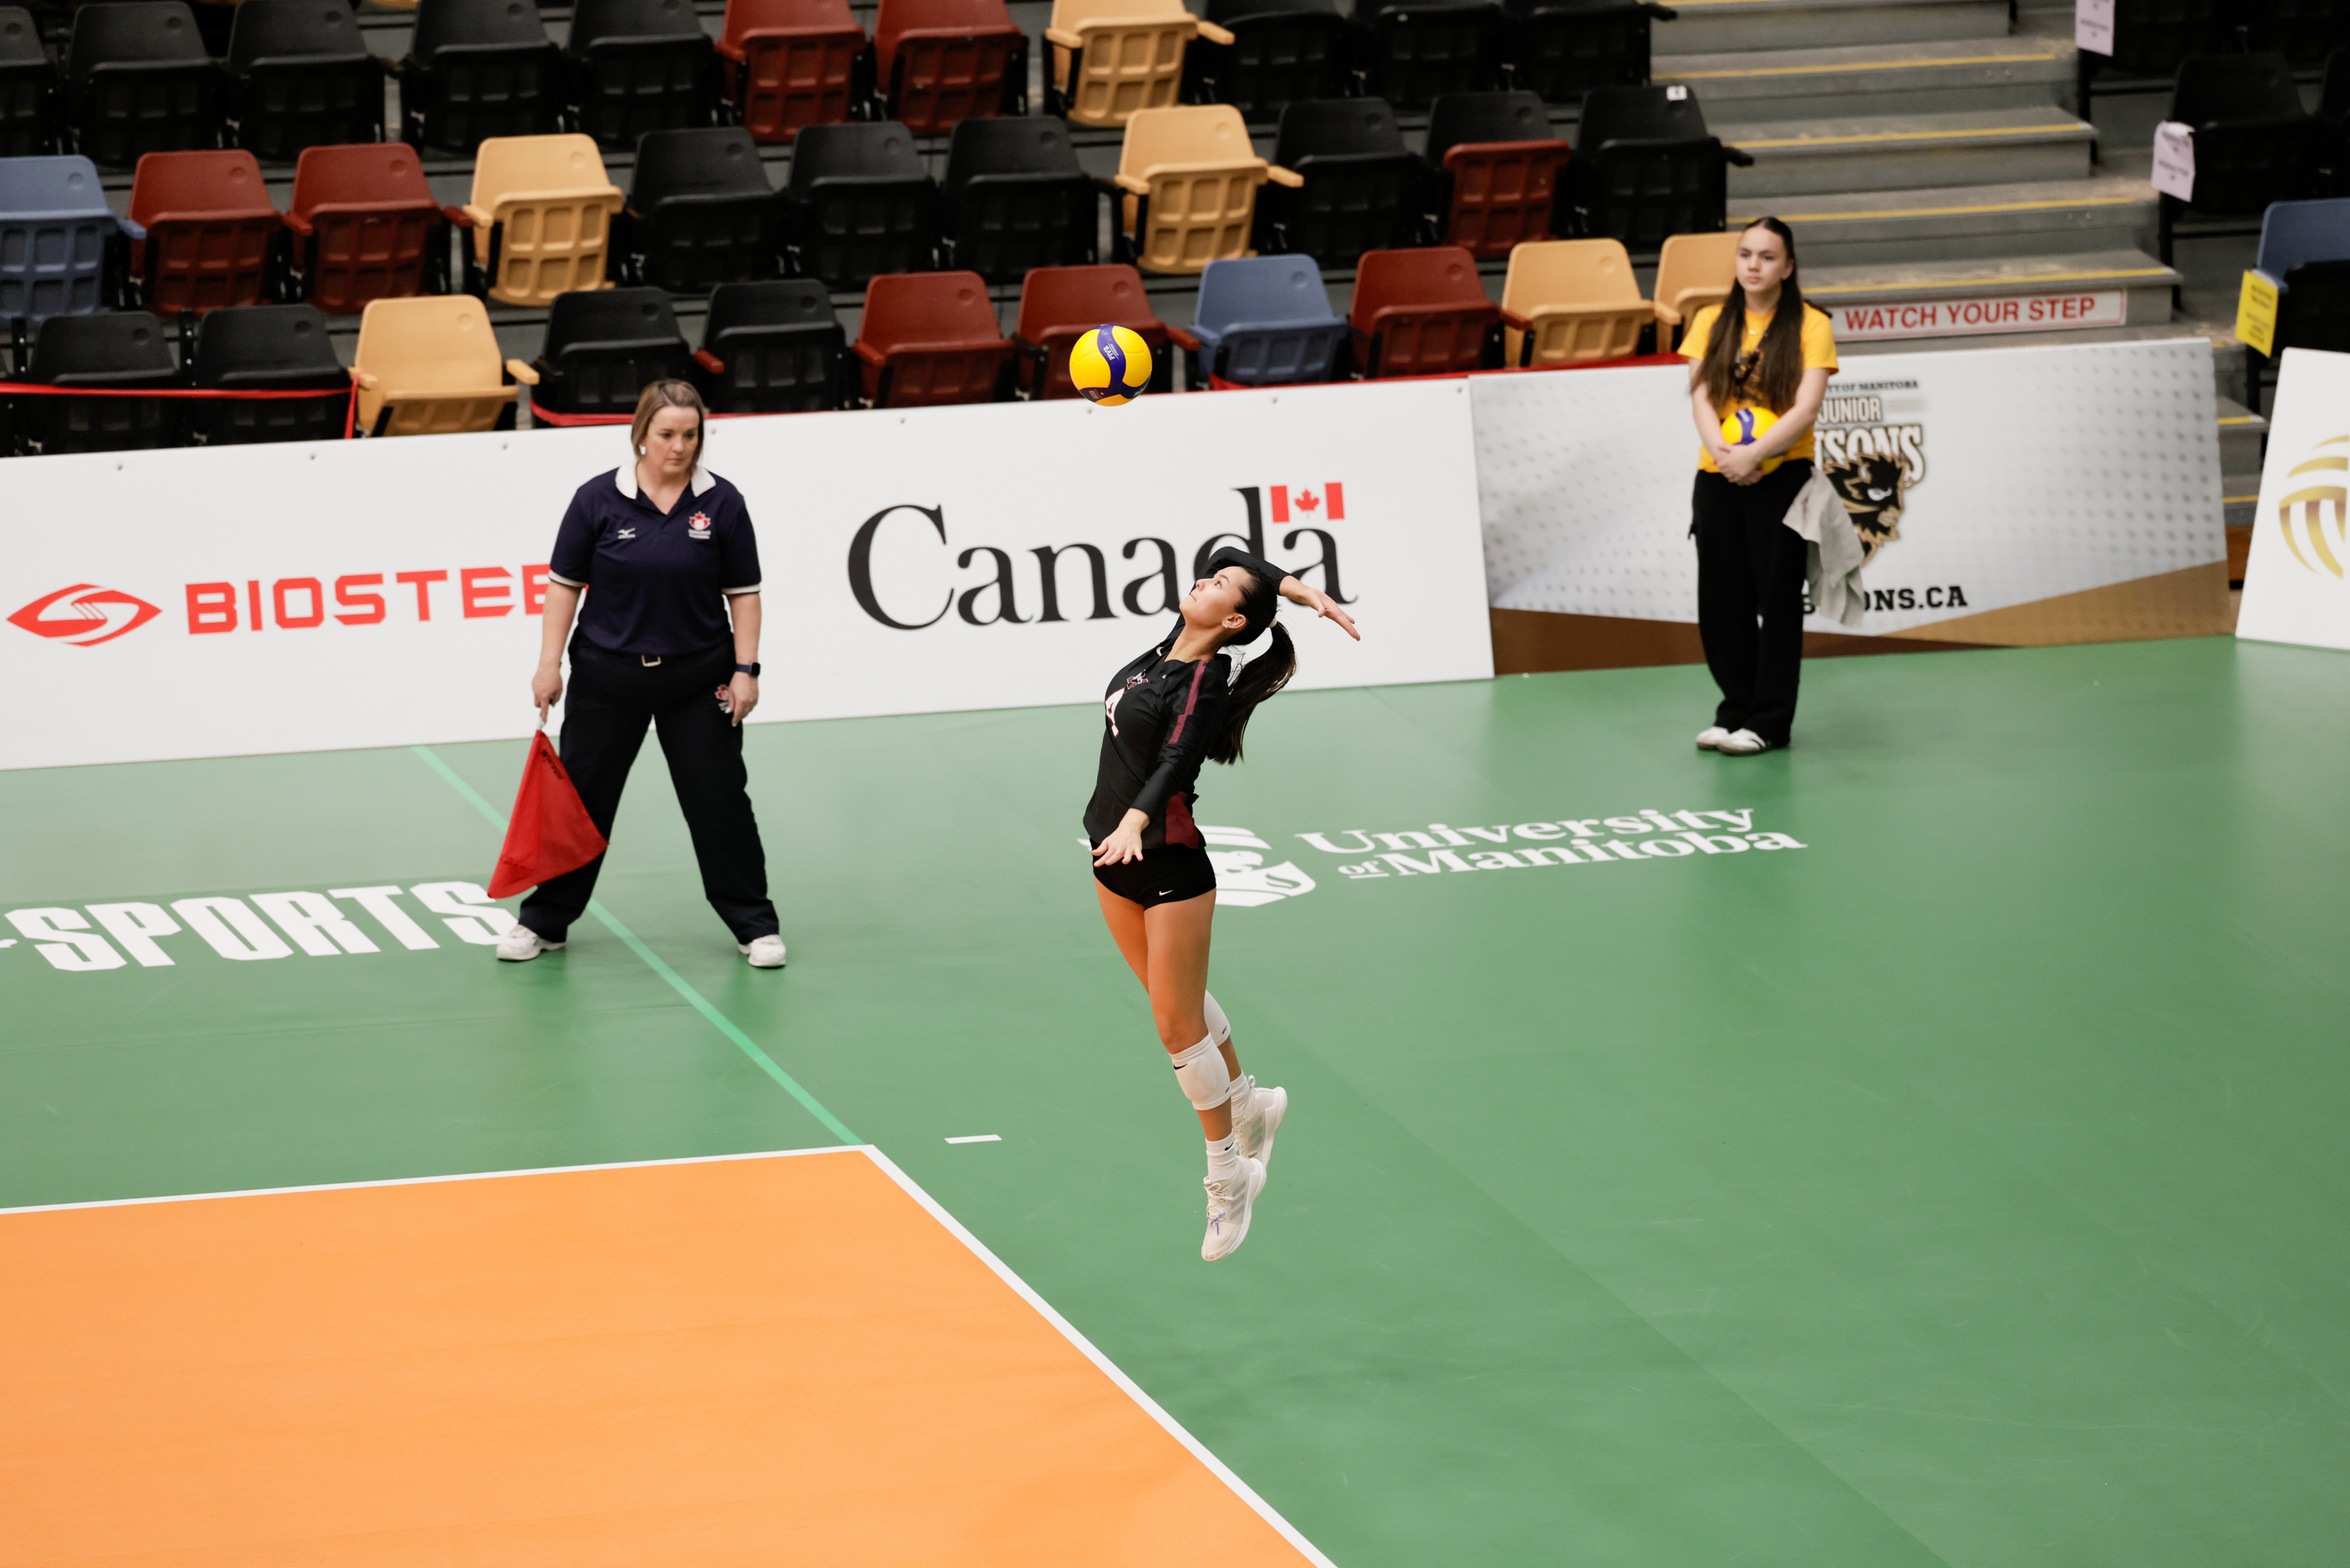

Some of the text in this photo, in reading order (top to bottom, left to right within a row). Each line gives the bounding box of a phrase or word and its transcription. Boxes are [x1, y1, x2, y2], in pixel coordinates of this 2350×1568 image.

[1845, 295, 2096, 331] WATCH YOUR STEP
[1859, 379, 1919, 391] MANITOBA
[1818, 396, 1882, 424] JUNIOR
[1813, 423, 1926, 484] ISONS
[185, 563, 590, 635] BIOSTEE
[1294, 808, 1755, 854] University
[1337, 830, 1808, 879] of Manitoba
[4, 880, 520, 972] SPORTS
